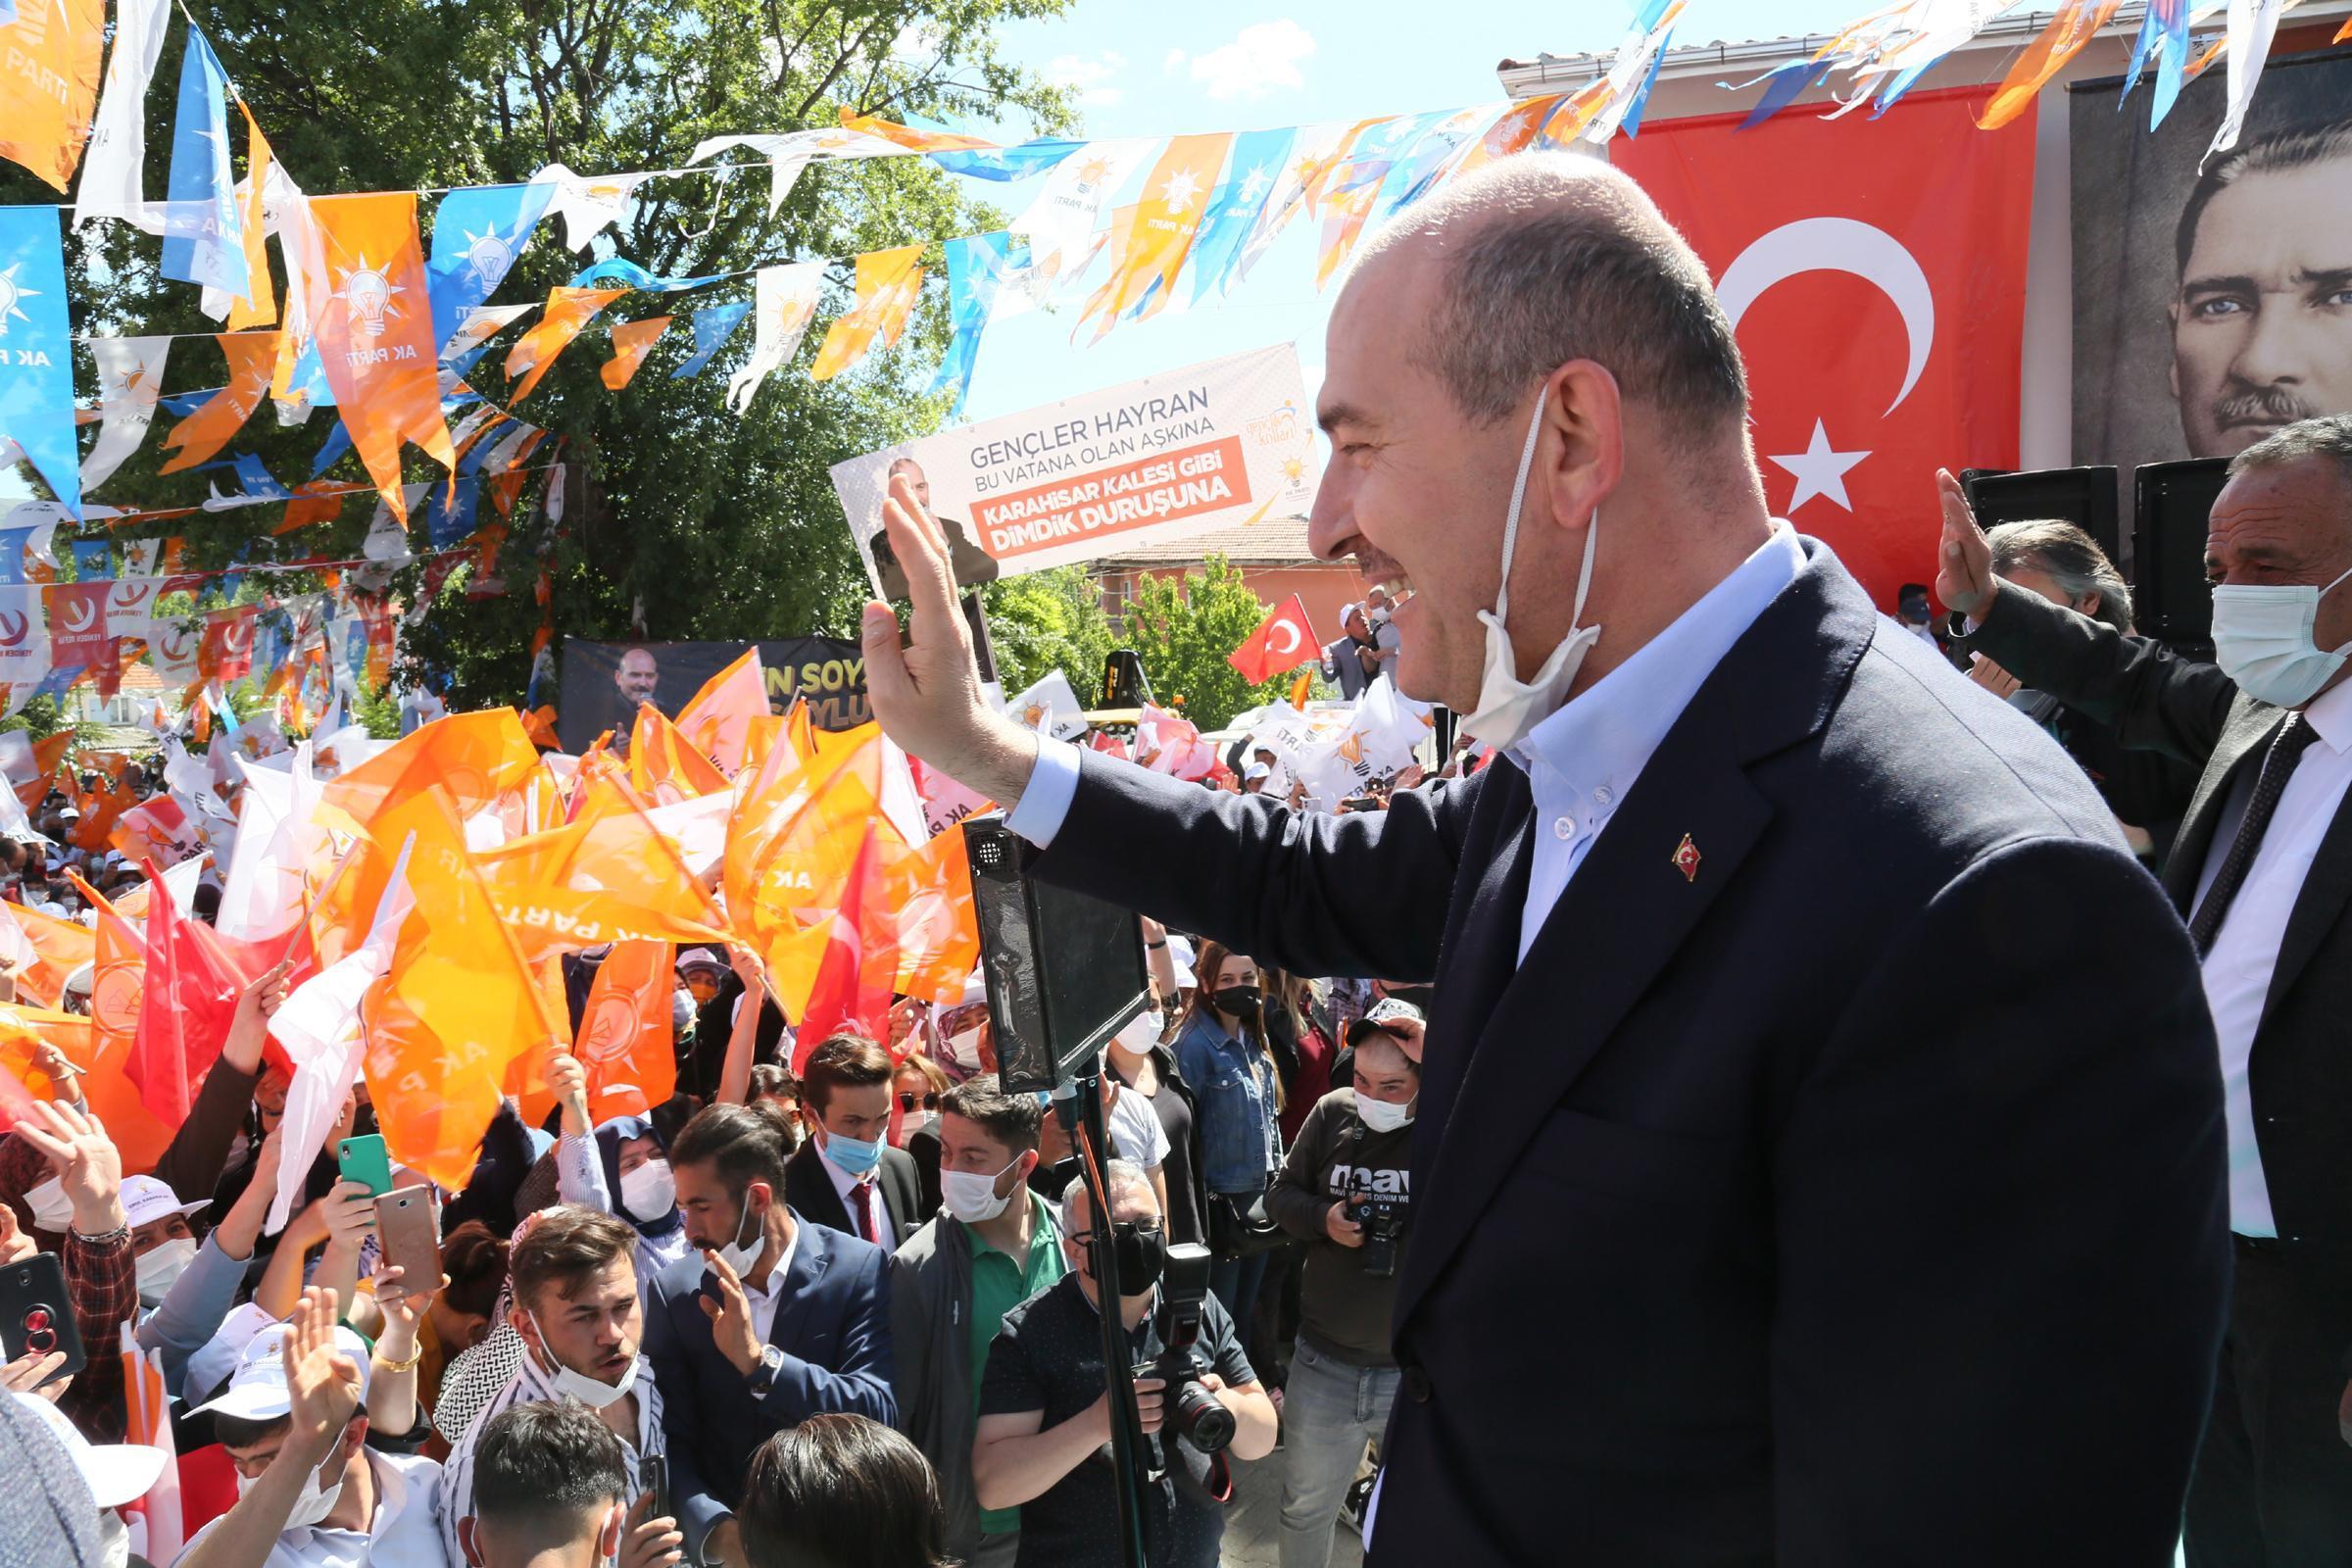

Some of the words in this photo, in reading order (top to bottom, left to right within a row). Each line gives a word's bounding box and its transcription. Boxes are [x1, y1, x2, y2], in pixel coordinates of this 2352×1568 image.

[970, 419, 1089, 468] GENÇLER
[1095, 386, 1209, 437] HAYRAN
[975, 471, 1000, 492] BU
[1003, 452, 1077, 484] VATANA
[1080, 436, 1135, 465] OLAN
[1141, 416, 1215, 450] AŞKINA
[1079, 475, 1233, 532] DURUŞUNA
[762, 665, 795, 698] N
[801, 658, 868, 694] SOY
